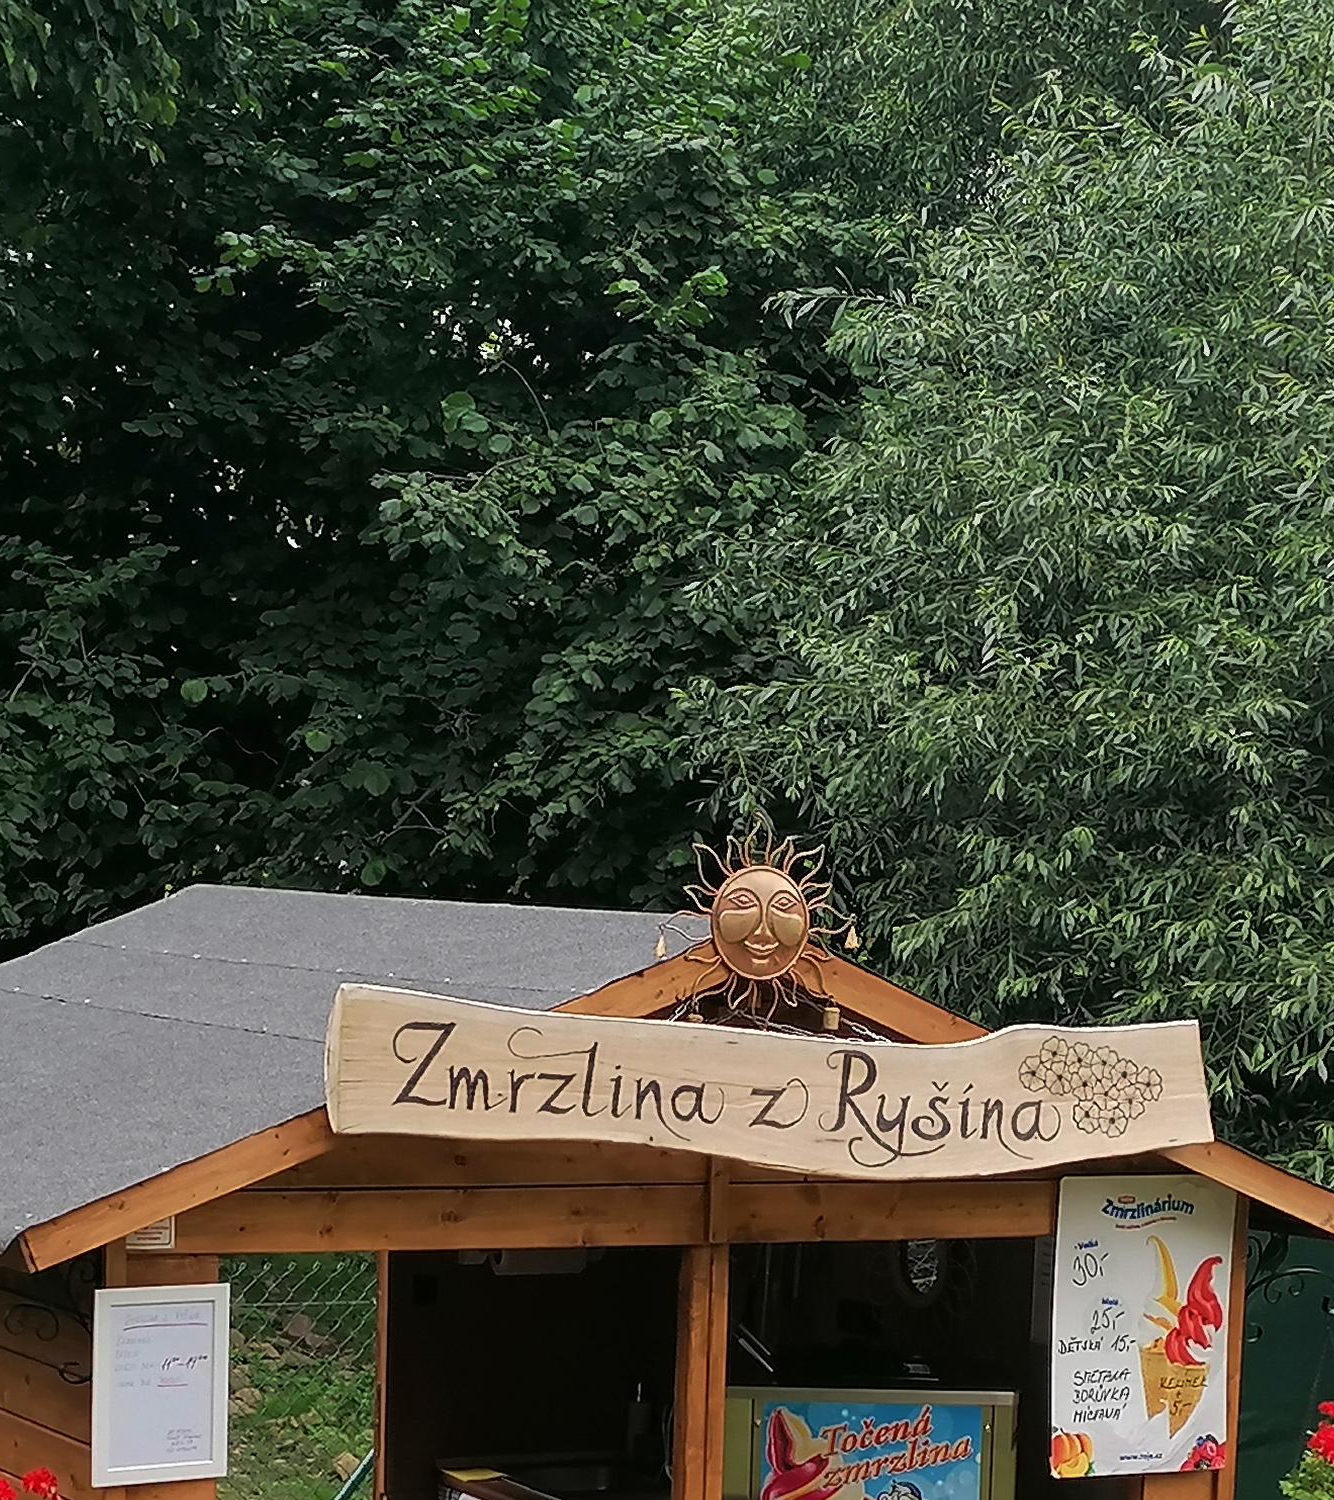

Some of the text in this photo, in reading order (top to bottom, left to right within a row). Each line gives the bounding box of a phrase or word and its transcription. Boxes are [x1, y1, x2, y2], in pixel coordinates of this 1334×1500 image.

[392, 1021, 1062, 1168] Zmrzlina z Ryšína
[1101, 1193, 1195, 1219] Zmrzlinárium
[820, 1405, 933, 1457] Točená
[823, 1435, 973, 1489] zmrzlina
